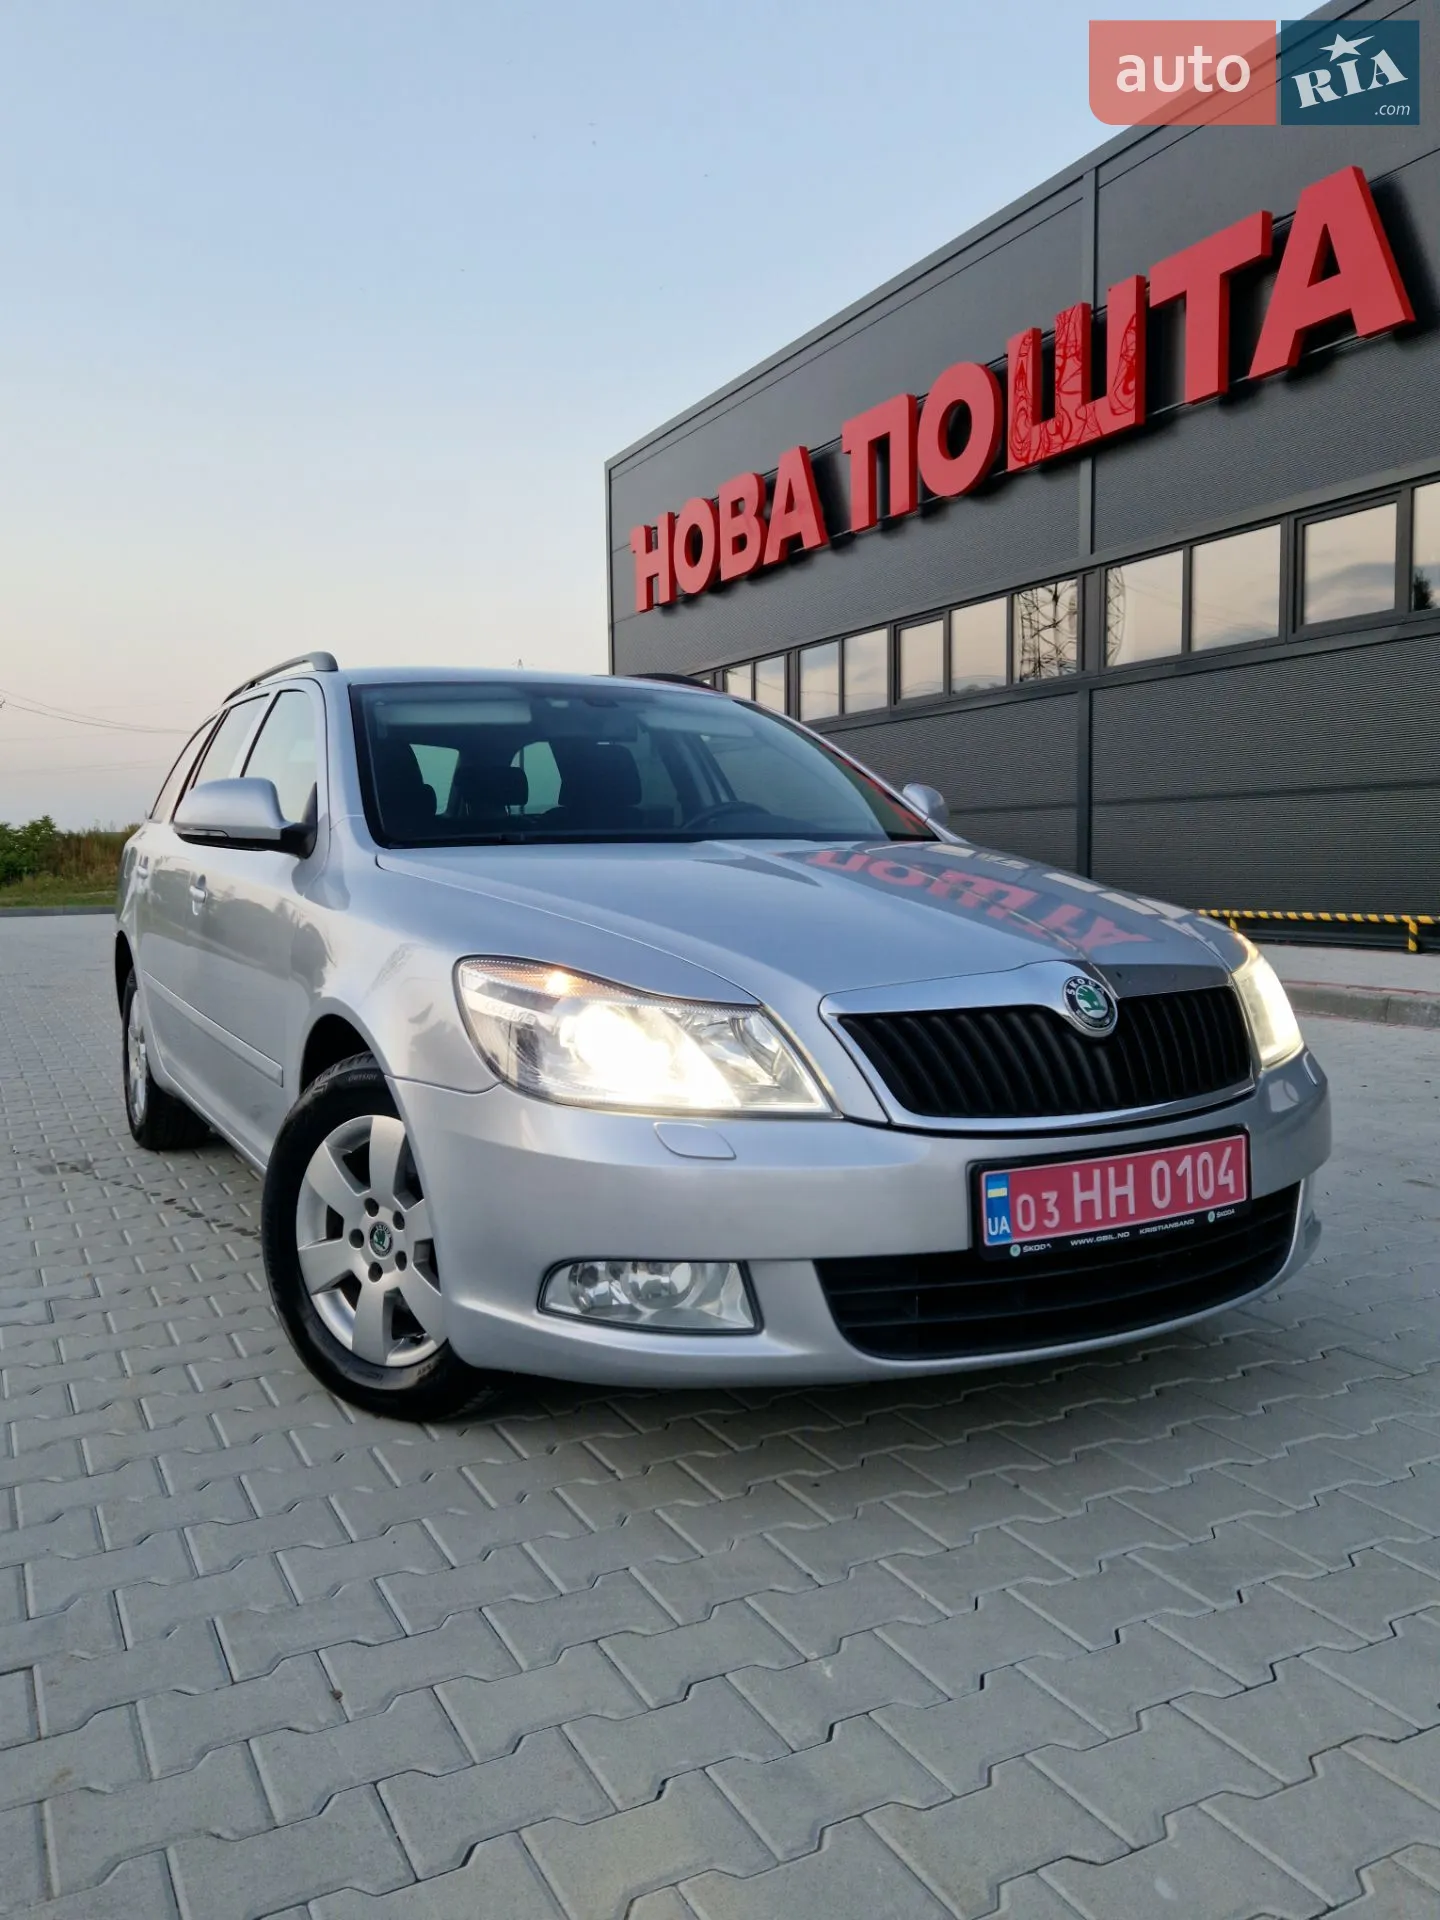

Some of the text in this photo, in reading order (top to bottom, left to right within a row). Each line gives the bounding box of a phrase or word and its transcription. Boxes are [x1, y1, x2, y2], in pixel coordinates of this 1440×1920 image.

[631, 165, 1415, 613] НОВА ПОШТА
[1016, 1146, 1235, 1232] 03 HH 0104
[988, 1216, 1011, 1236] UA
[1139, 1218, 1195, 1235] KRISTIANSAND
